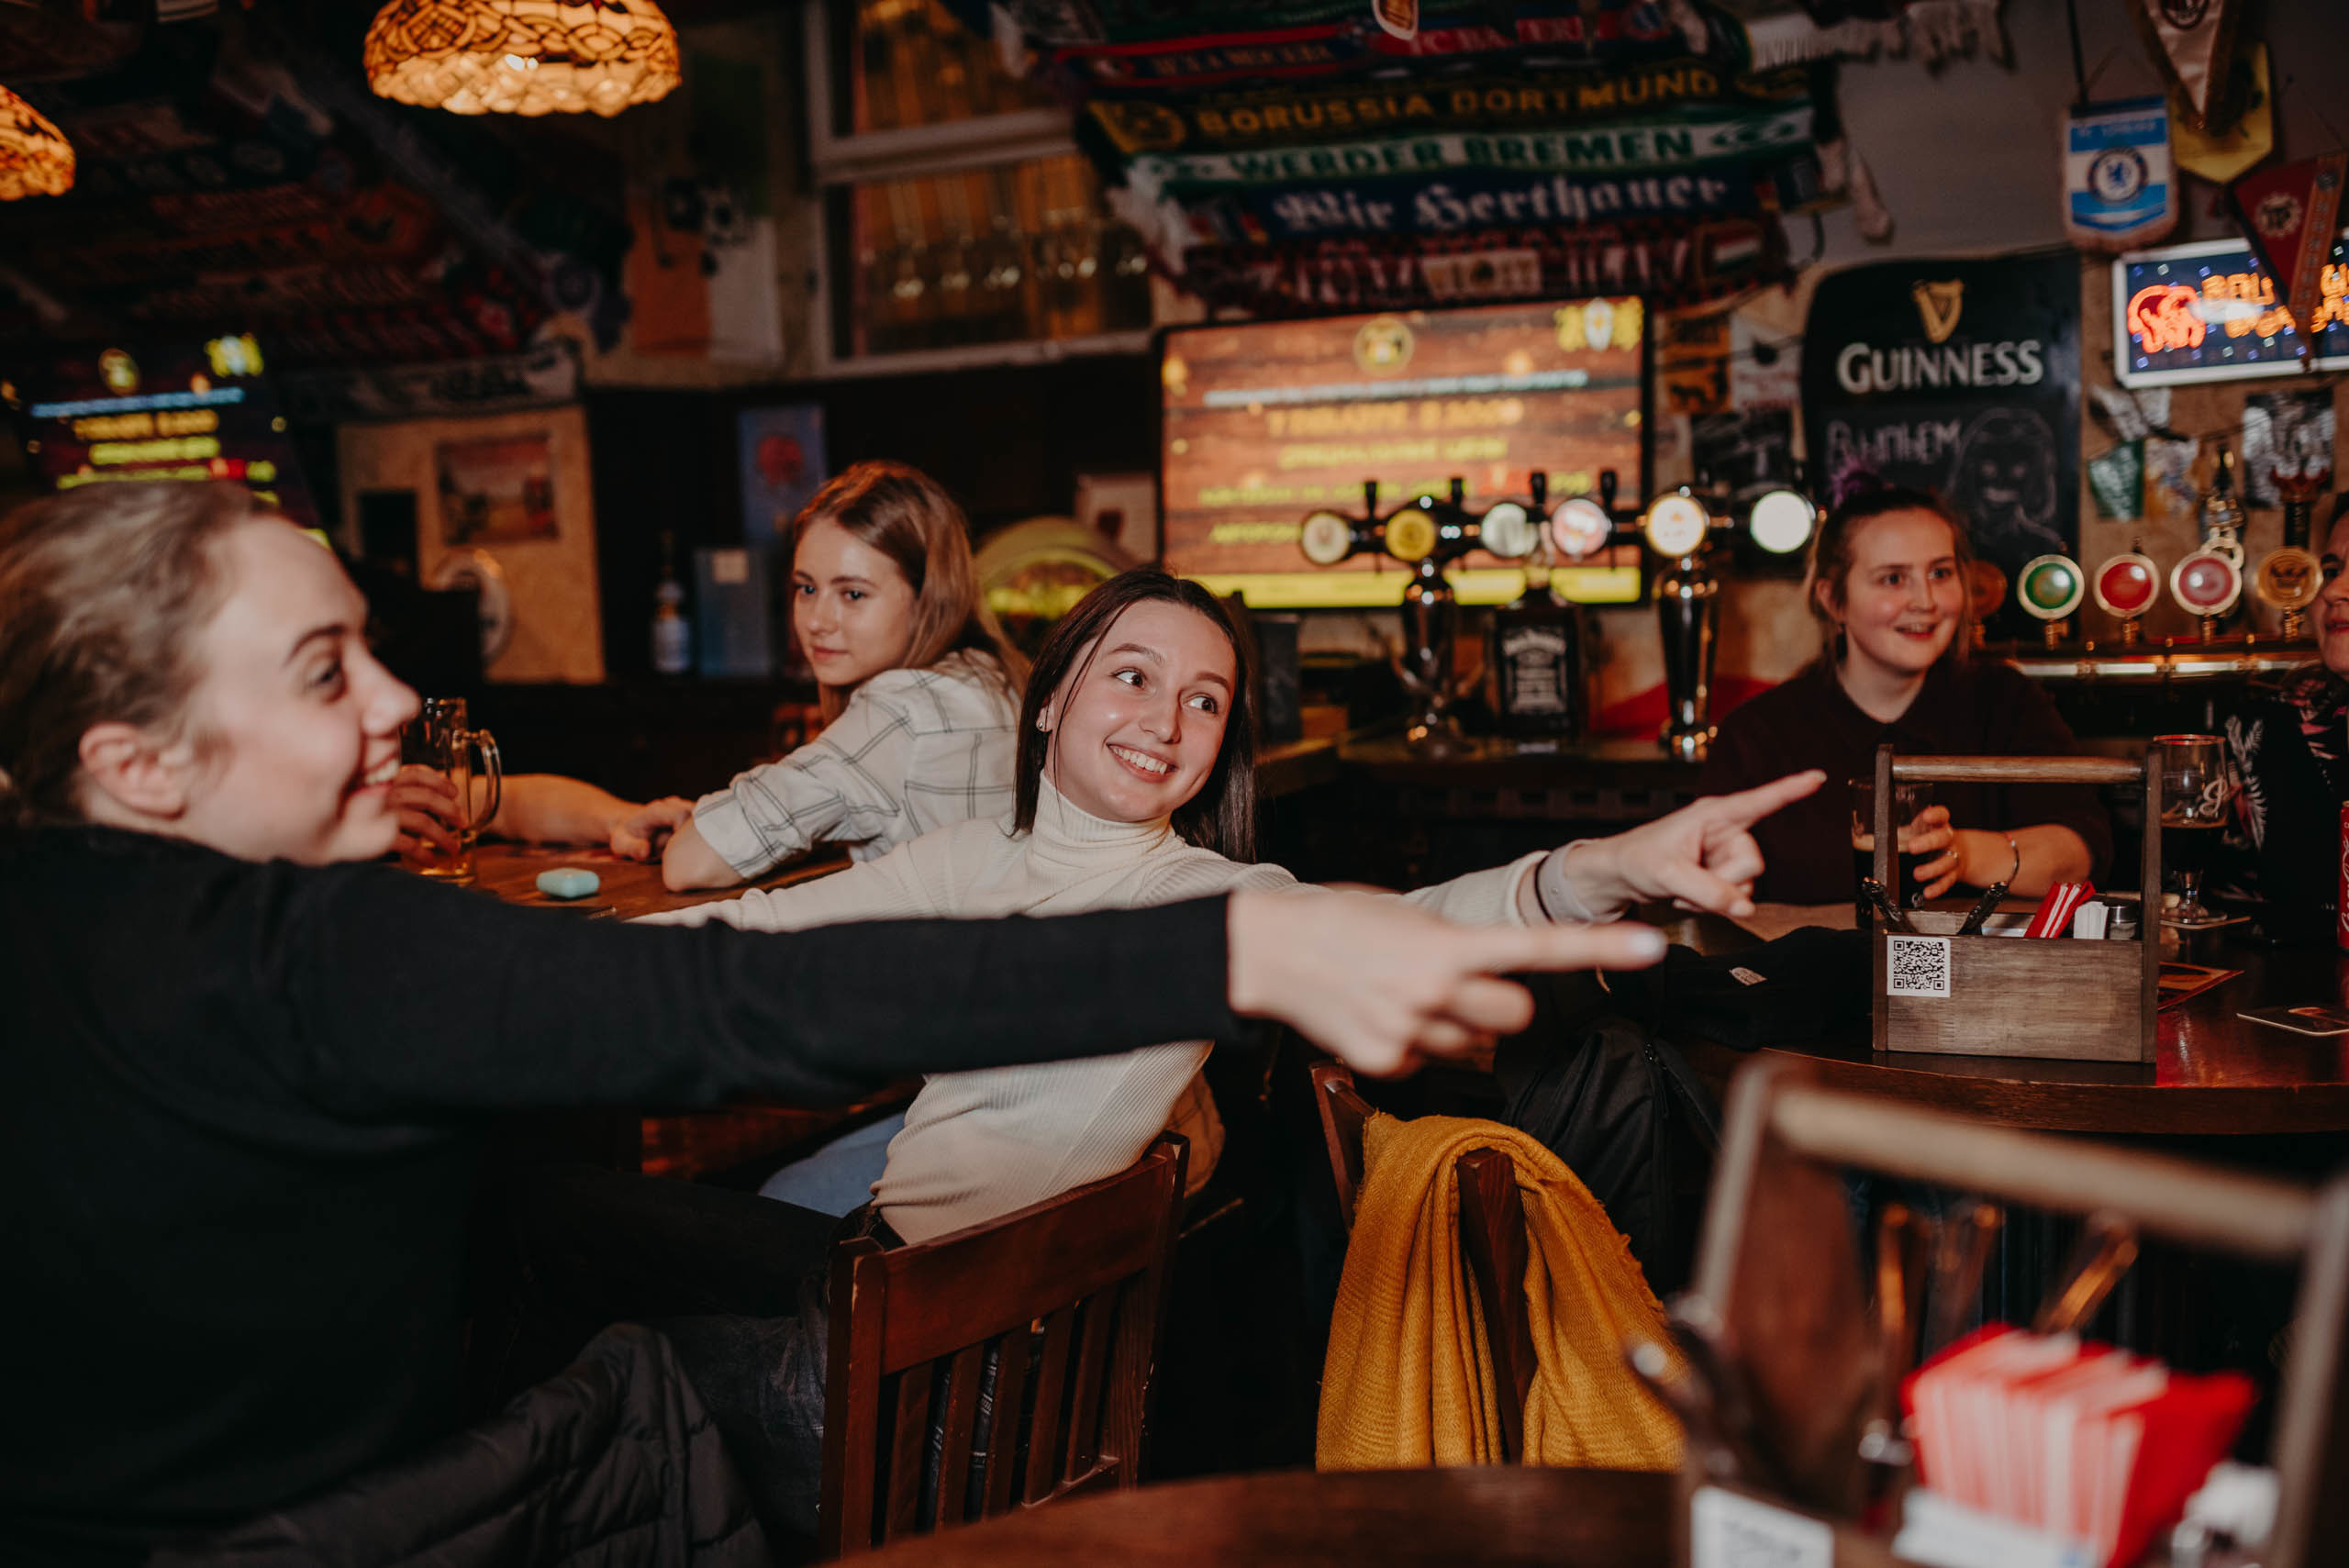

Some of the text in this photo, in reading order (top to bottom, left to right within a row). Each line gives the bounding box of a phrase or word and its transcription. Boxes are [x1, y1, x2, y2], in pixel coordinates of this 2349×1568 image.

[1197, 68, 1719, 135] BORUSSIA DORTMUND
[1230, 130, 1692, 178] WERDER BREMEN
[1271, 190, 1396, 231] Wir
[1838, 339, 2044, 395] GUINNESS
